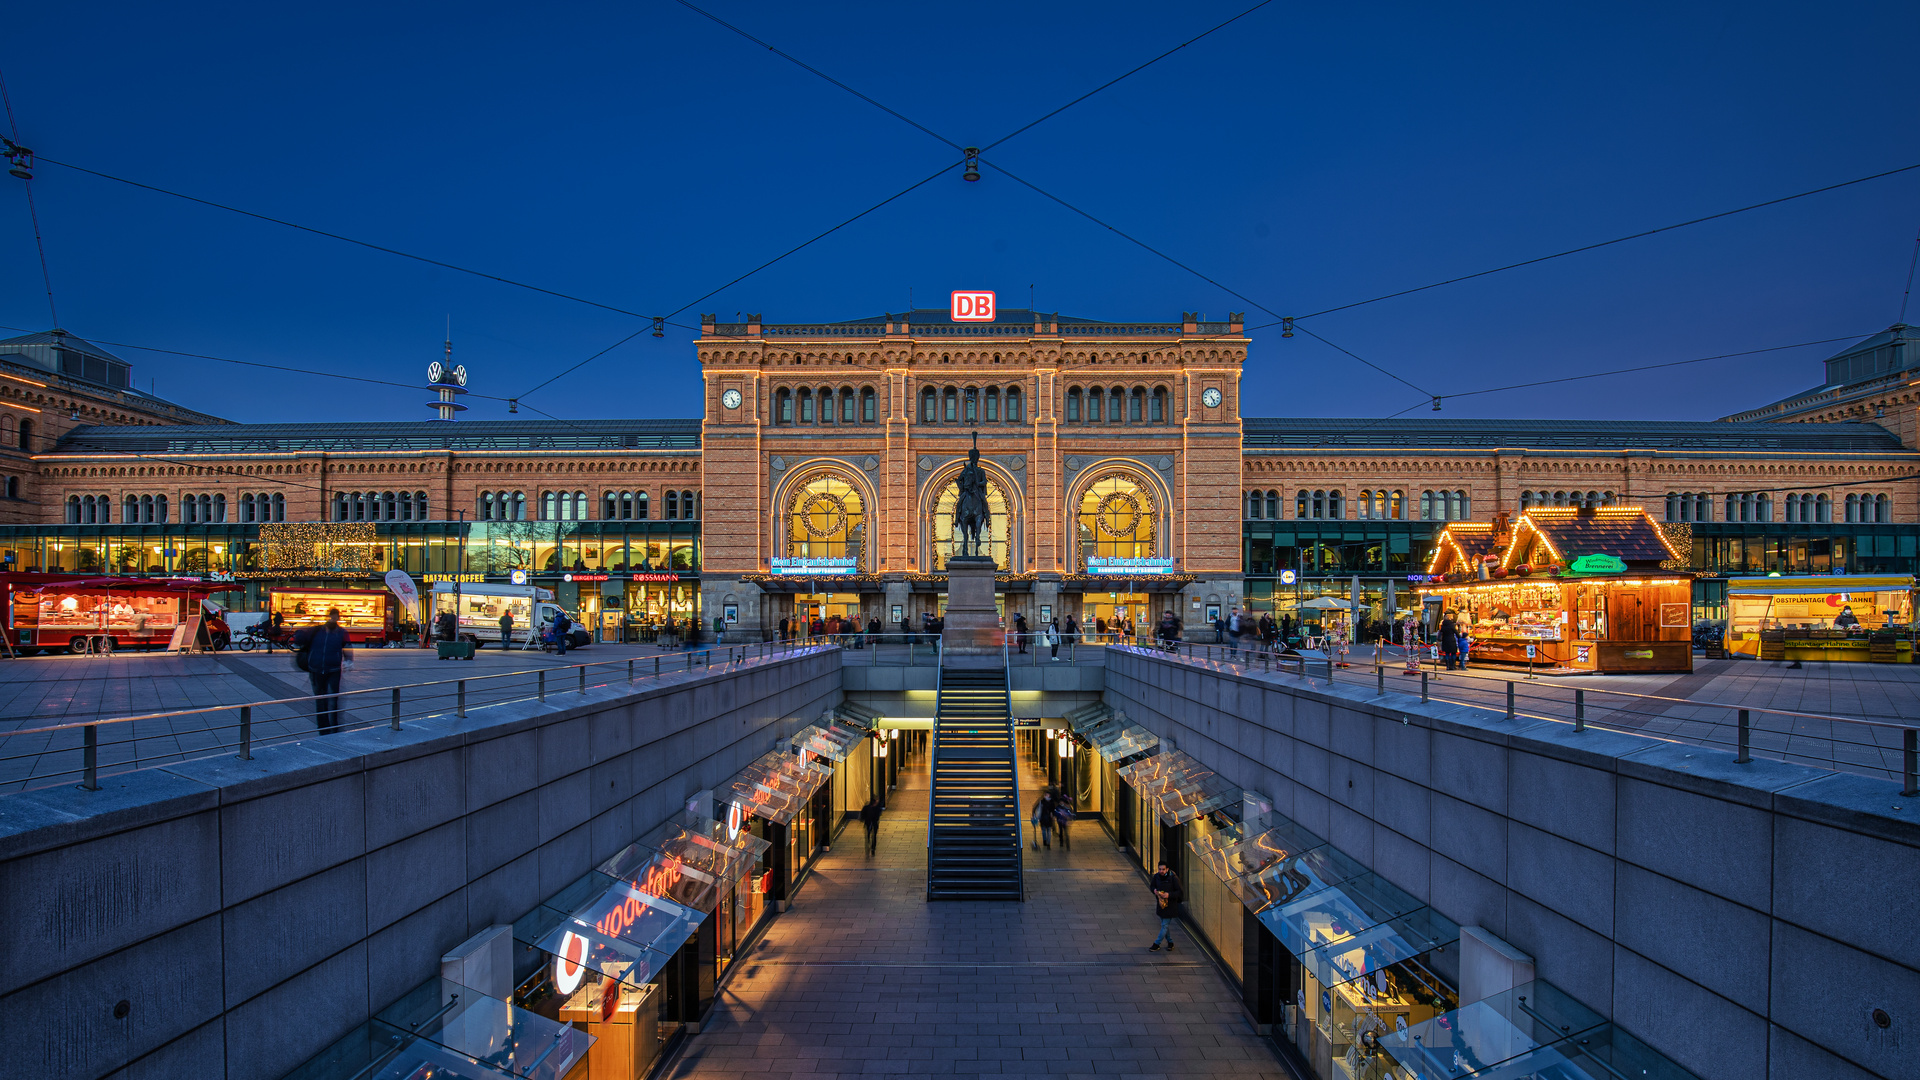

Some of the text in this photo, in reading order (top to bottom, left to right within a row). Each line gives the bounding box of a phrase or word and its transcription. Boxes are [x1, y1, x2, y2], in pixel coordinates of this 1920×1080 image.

[957, 296, 991, 316] DB
[1088, 556, 1174, 566] Mein Einkaufsbahnhof
[633, 573, 678, 581] ROSSMANN
